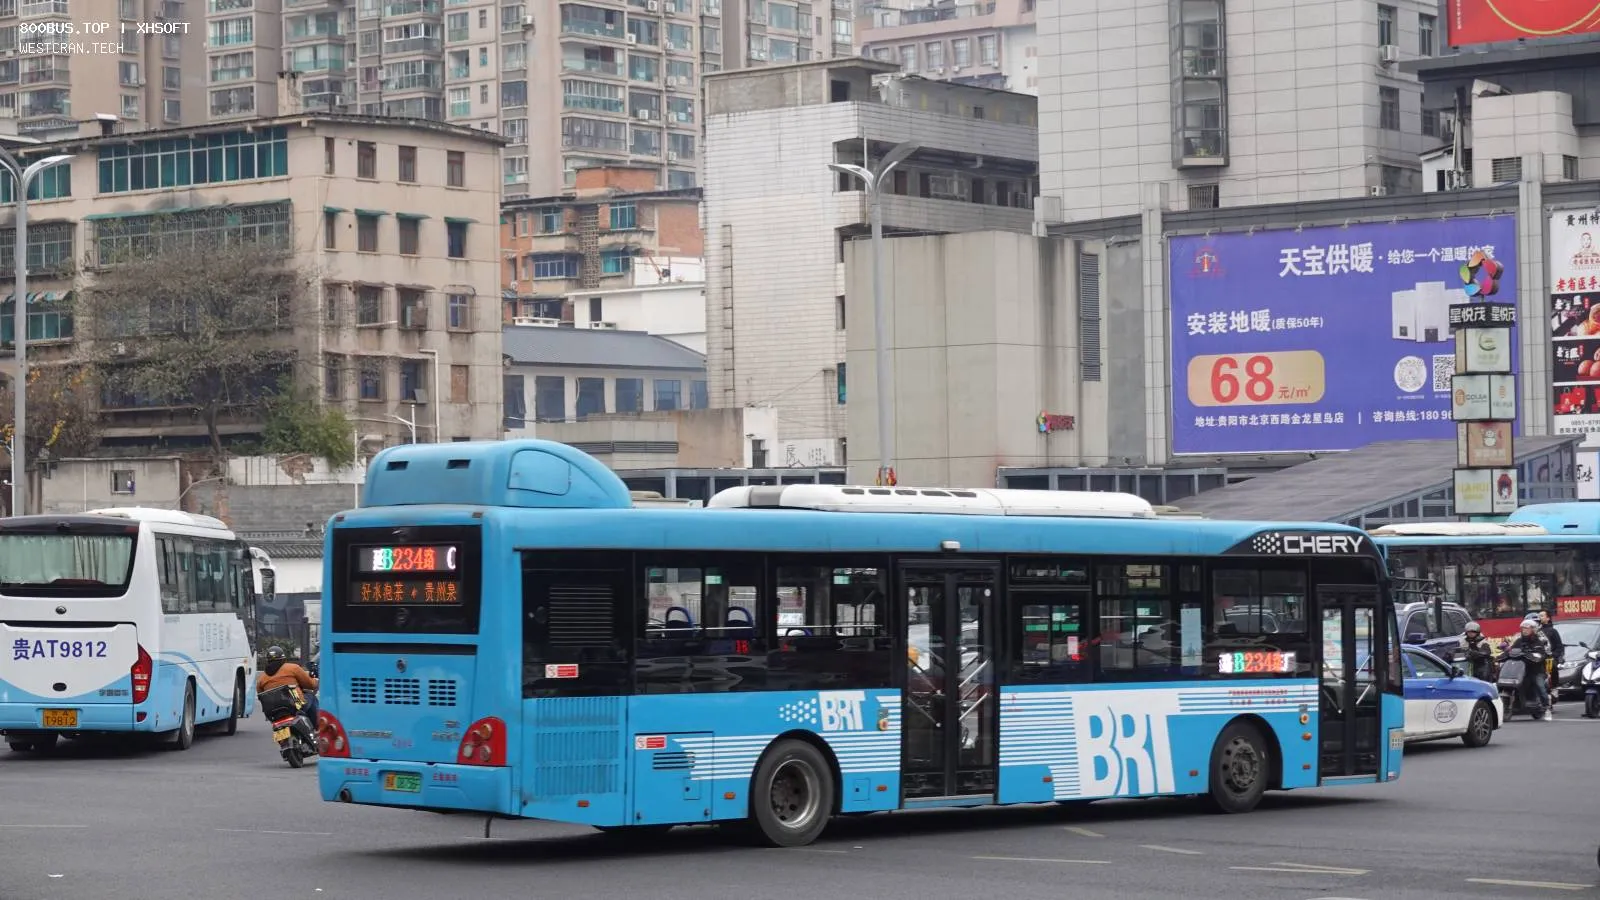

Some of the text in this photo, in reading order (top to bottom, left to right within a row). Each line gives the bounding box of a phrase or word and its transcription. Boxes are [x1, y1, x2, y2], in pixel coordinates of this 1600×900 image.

[1279, 242, 1374, 277] 天宝供暖
[1556, 276, 1600, 291] 老省医手
[1187, 309, 1271, 335] 安装地暖
[1450, 307, 1486, 323] 星悦茂
[1211, 356, 1275, 403] 68
[1283, 535, 1364, 554] CHERY
[12, 637, 108, 660] 贵AT9812
[44, 715, 76, 726] T9812
[818, 690, 866, 731] BRT
[1072, 689, 1181, 798] BRT
